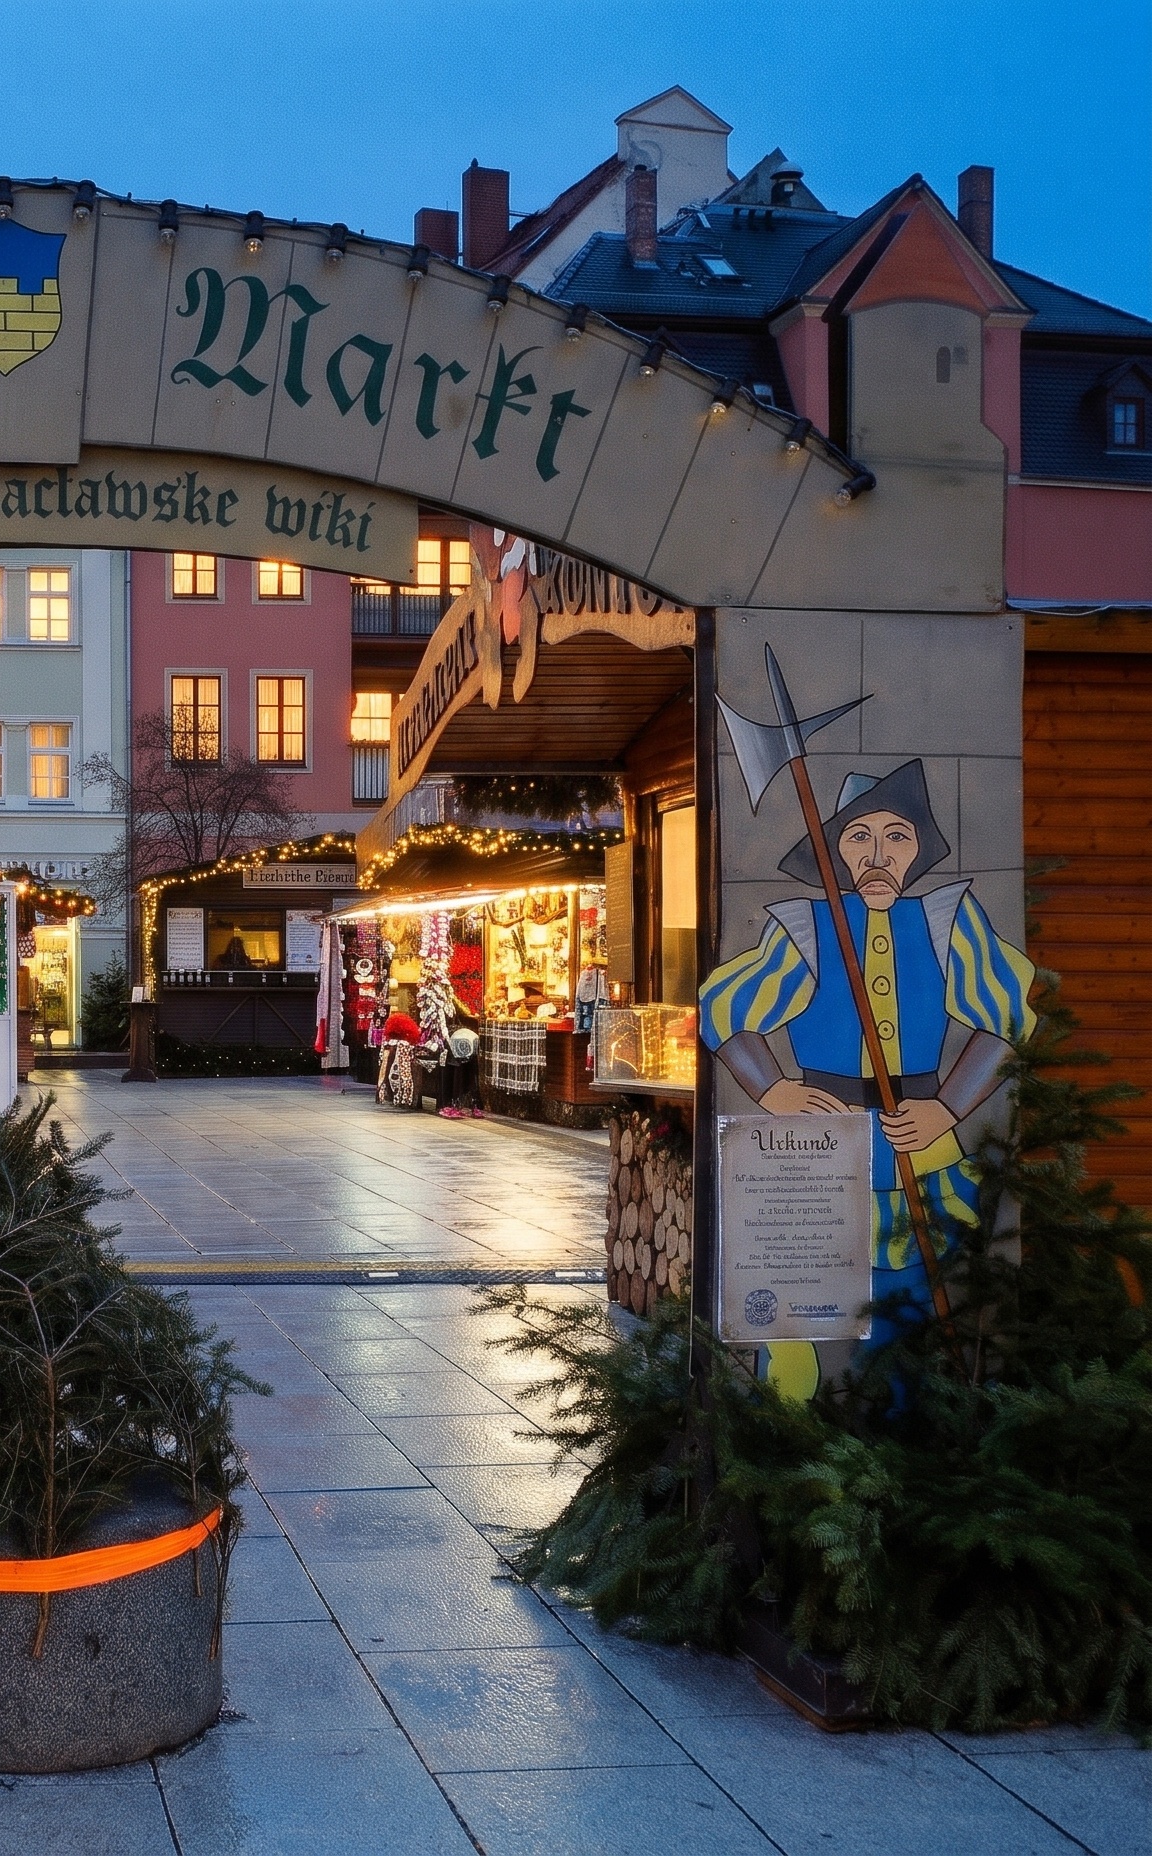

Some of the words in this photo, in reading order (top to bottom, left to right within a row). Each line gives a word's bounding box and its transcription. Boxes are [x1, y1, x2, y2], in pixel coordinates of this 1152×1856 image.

[170, 267, 592, 483] Markt
[264, 484, 377, 554] wiki
[750, 1129, 838, 1151] Urkunde
